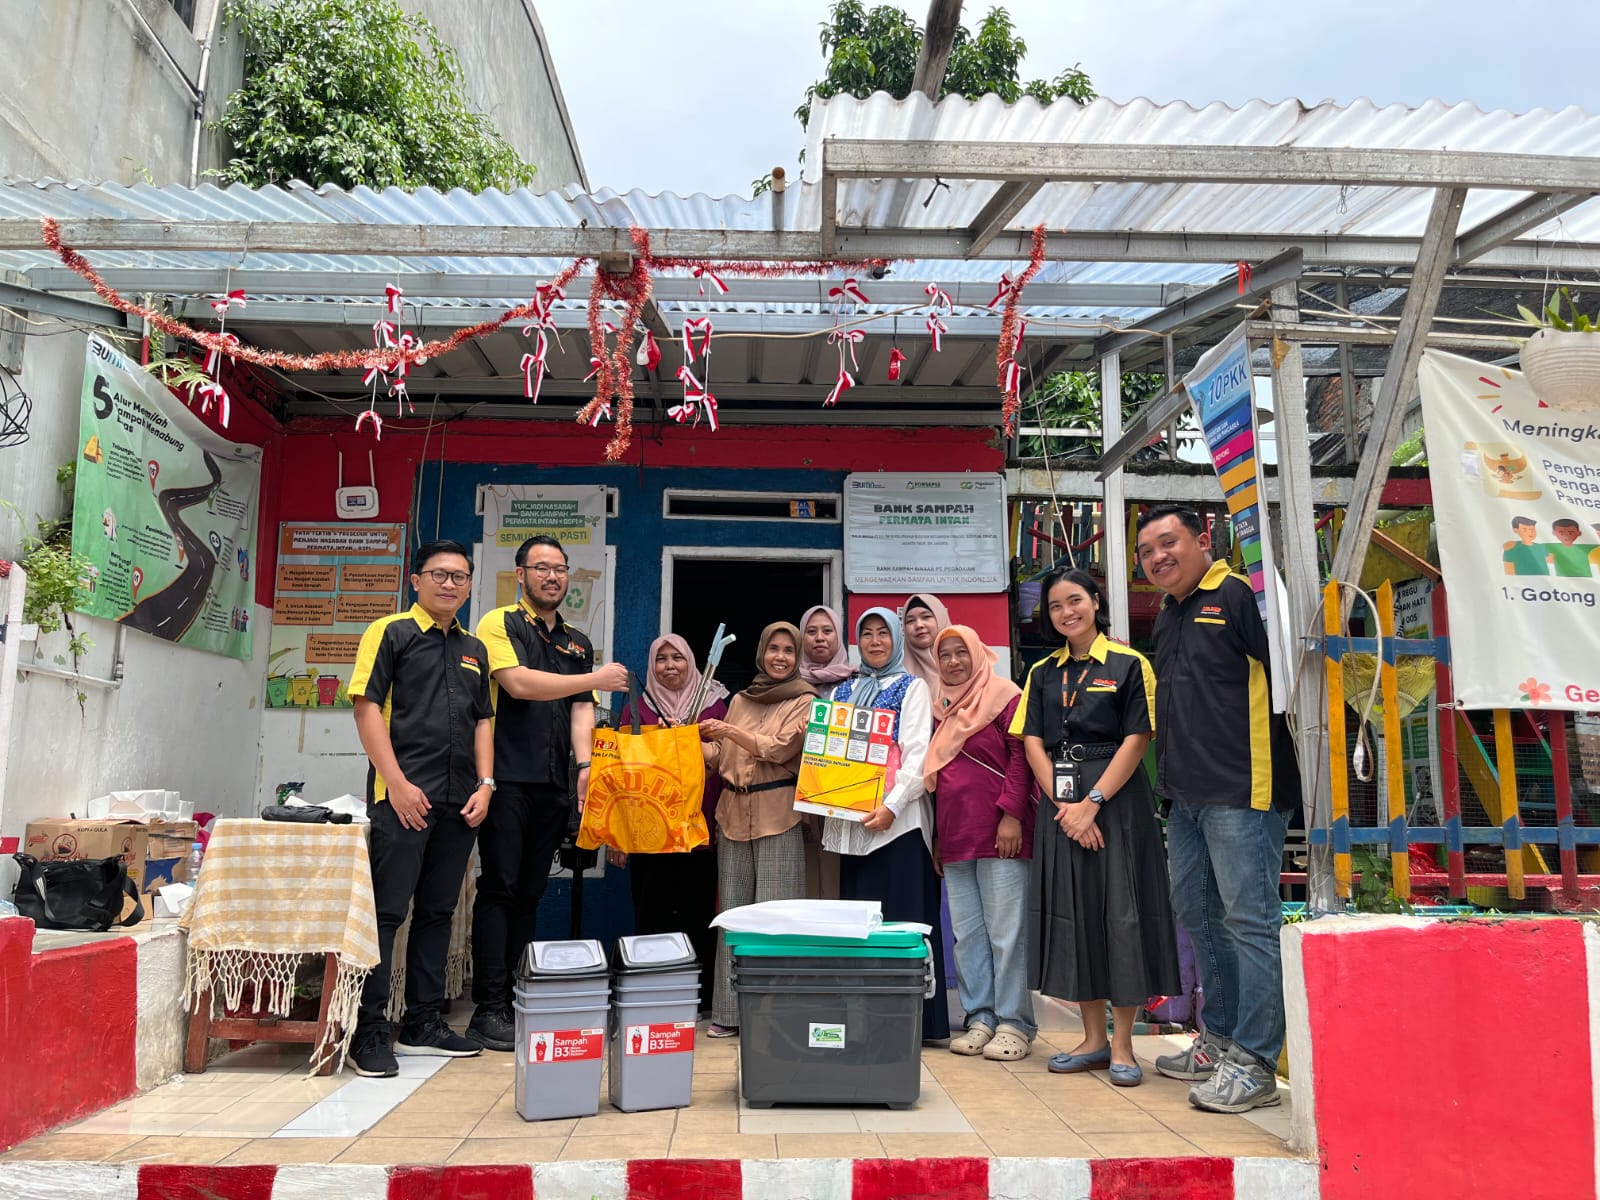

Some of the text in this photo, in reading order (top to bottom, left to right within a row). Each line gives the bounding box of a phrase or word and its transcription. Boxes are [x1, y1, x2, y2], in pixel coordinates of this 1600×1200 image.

[93, 375, 114, 420] 5
[113, 392, 168, 428] Alur Memilah
[1502, 418, 1600, 442] Meningk
[874, 504, 975, 513] BANK SAMPAH
[879, 516, 970, 525] PERMATA INTAN
[500, 532, 534, 542] SEMUA
[561, 531, 587, 540] PASTI
[1502, 586, 1596, 607] 1. Gotong
[1564, 684, 1600, 703] Ge
[650, 1030, 681, 1040] Sampah
[554, 1036, 588, 1046] Sampah
[649, 1039, 664, 1050] B3
[554, 1046, 569, 1057] B3
